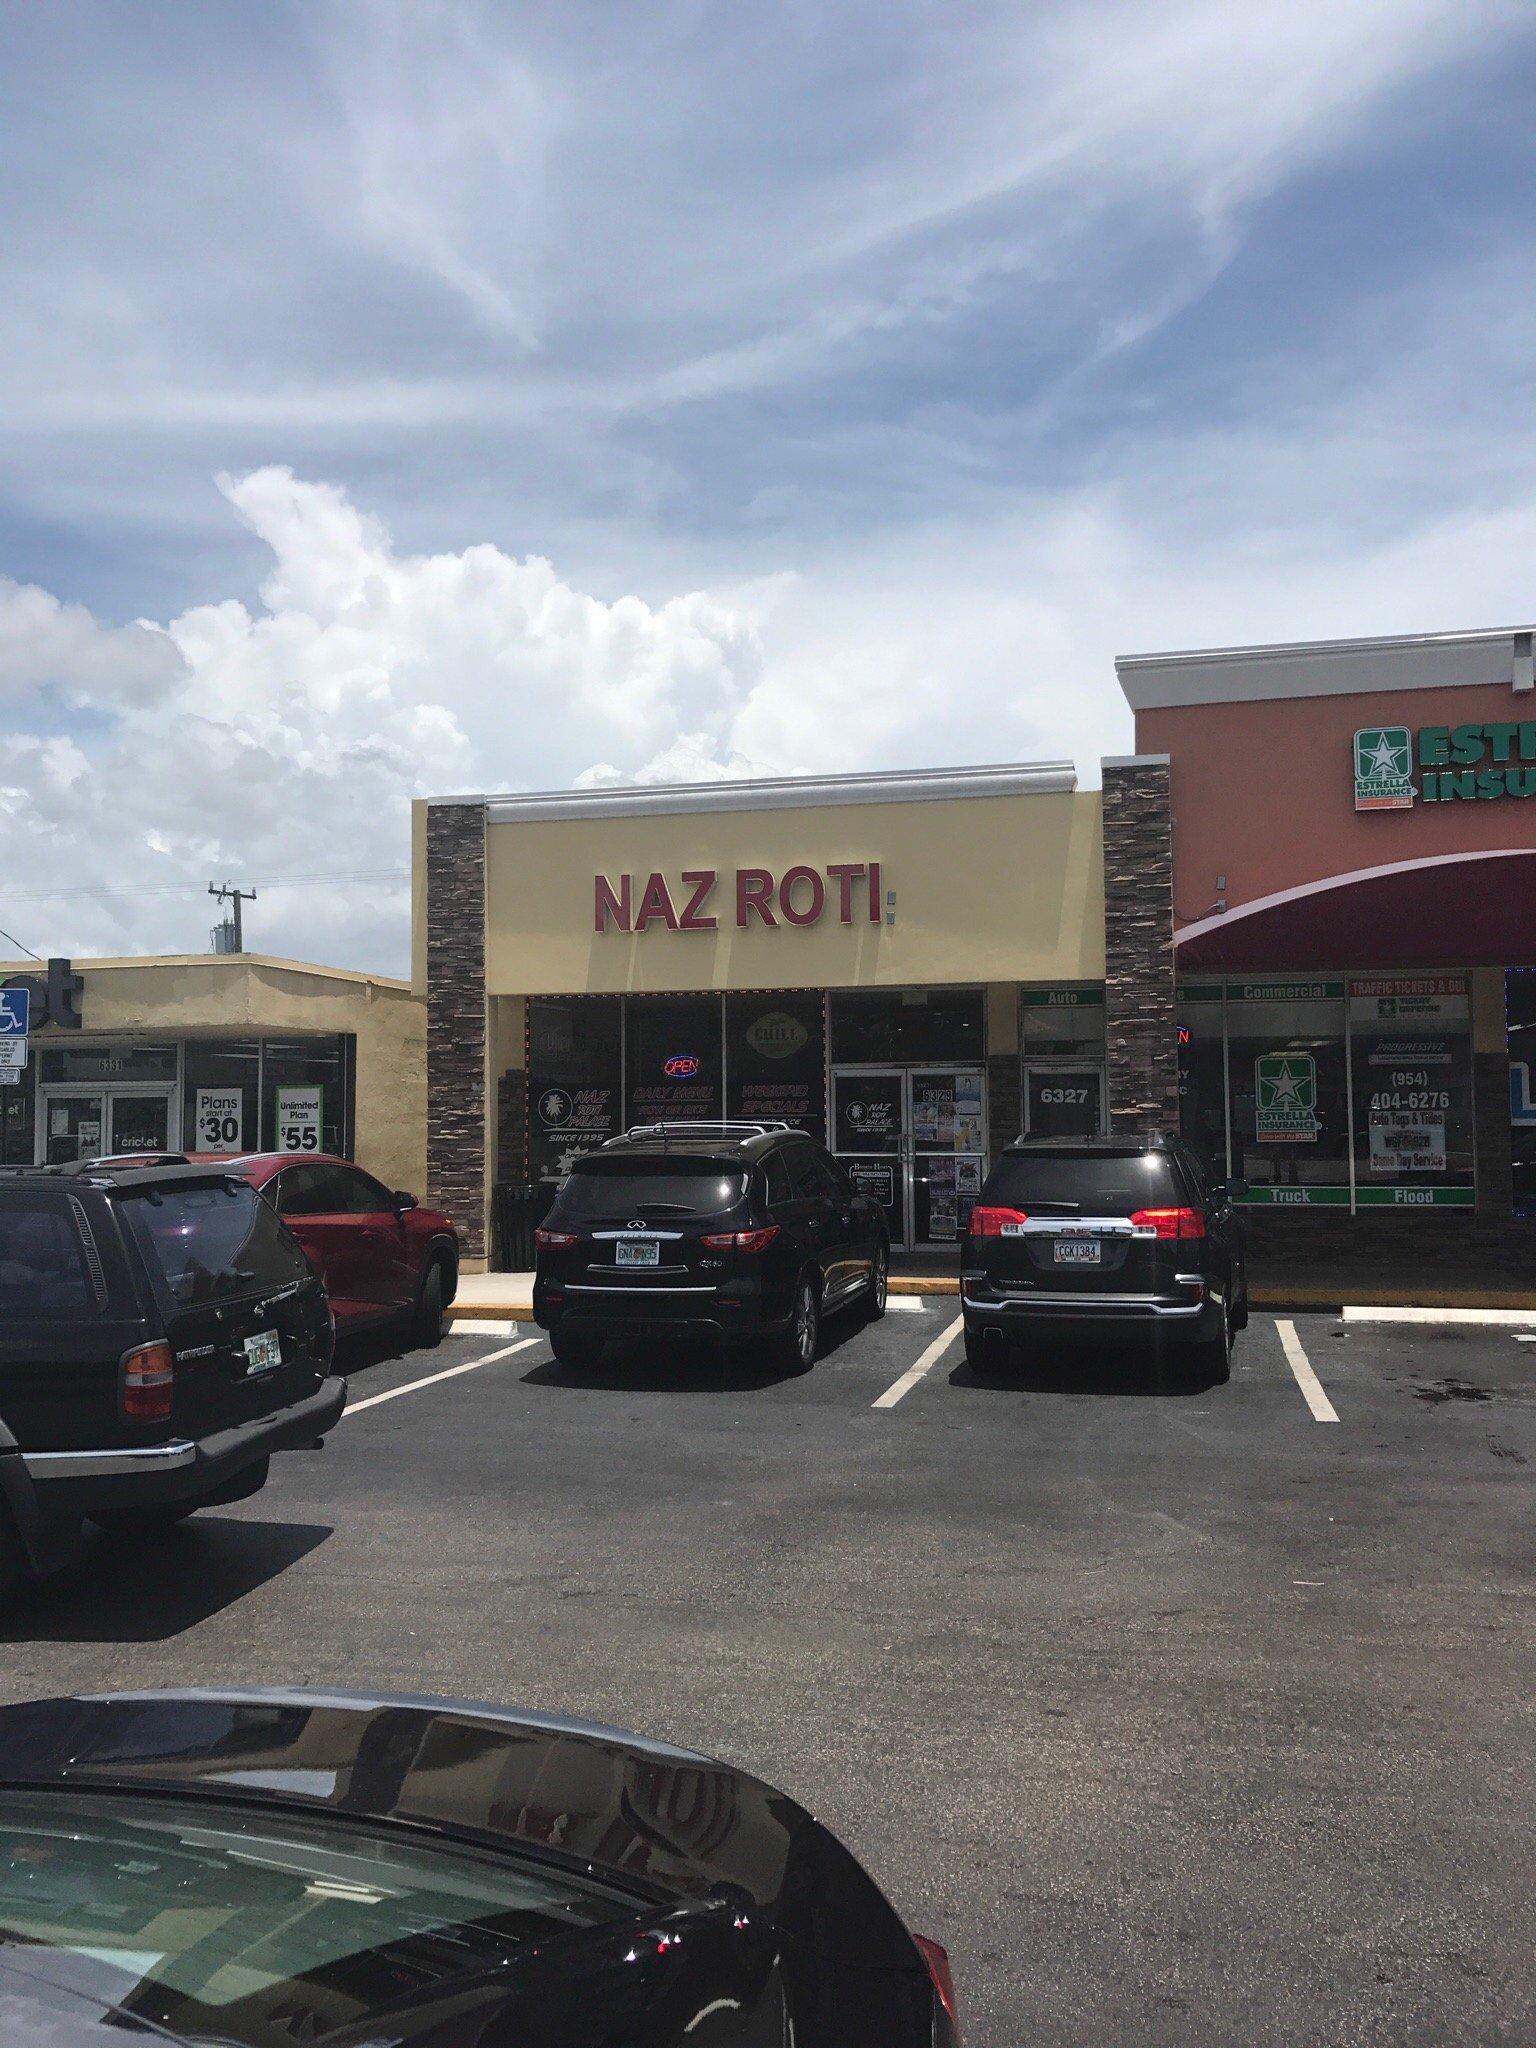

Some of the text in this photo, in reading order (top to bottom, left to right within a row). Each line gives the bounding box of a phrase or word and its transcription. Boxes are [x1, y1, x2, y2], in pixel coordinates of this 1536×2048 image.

[1356, 779, 1410, 791] ESTRELLA
[1356, 787, 1412, 798] INSURANCE
[594, 863, 881, 932] NAZ ROTI
[1243, 983, 1326, 999] Commercial
[1352, 980, 1393, 995] TRAFFIC
[1394, 980, 1435, 994] TICKETS
[1047, 991, 1078, 1004] Auto
[664, 1058, 699, 1075] OPEN
[1392, 1070, 1428, 1087] (954)
[201, 1096, 238, 1108] Plans
[574, 1089, 611, 1104] NAZ
[924, 1090, 952, 1101] 6329
[1040, 1088, 1088, 1104] 6327
[1370, 1091, 1450, 1109] 404-6276
[280, 1101, 319, 1110] Unlimited
[868, 1102, 892, 1112] NAZ
[290, 1110, 309, 1119] Plan
[1257, 1111, 1313, 1121] ESTRELLA
[200, 1117, 239, 1143] $30
[1257, 1120, 1316, 1130] INSURANCE
[281, 1126, 318, 1150] $55
[548, 1133, 605, 1142] SINCE 1995
[1413, 1152, 1444, 1166] Service
[1270, 1188, 1311, 1202] Truck
[1394, 1189, 1434, 1203] Flood
[1058, 1245, 1096, 1258] CGK1384
